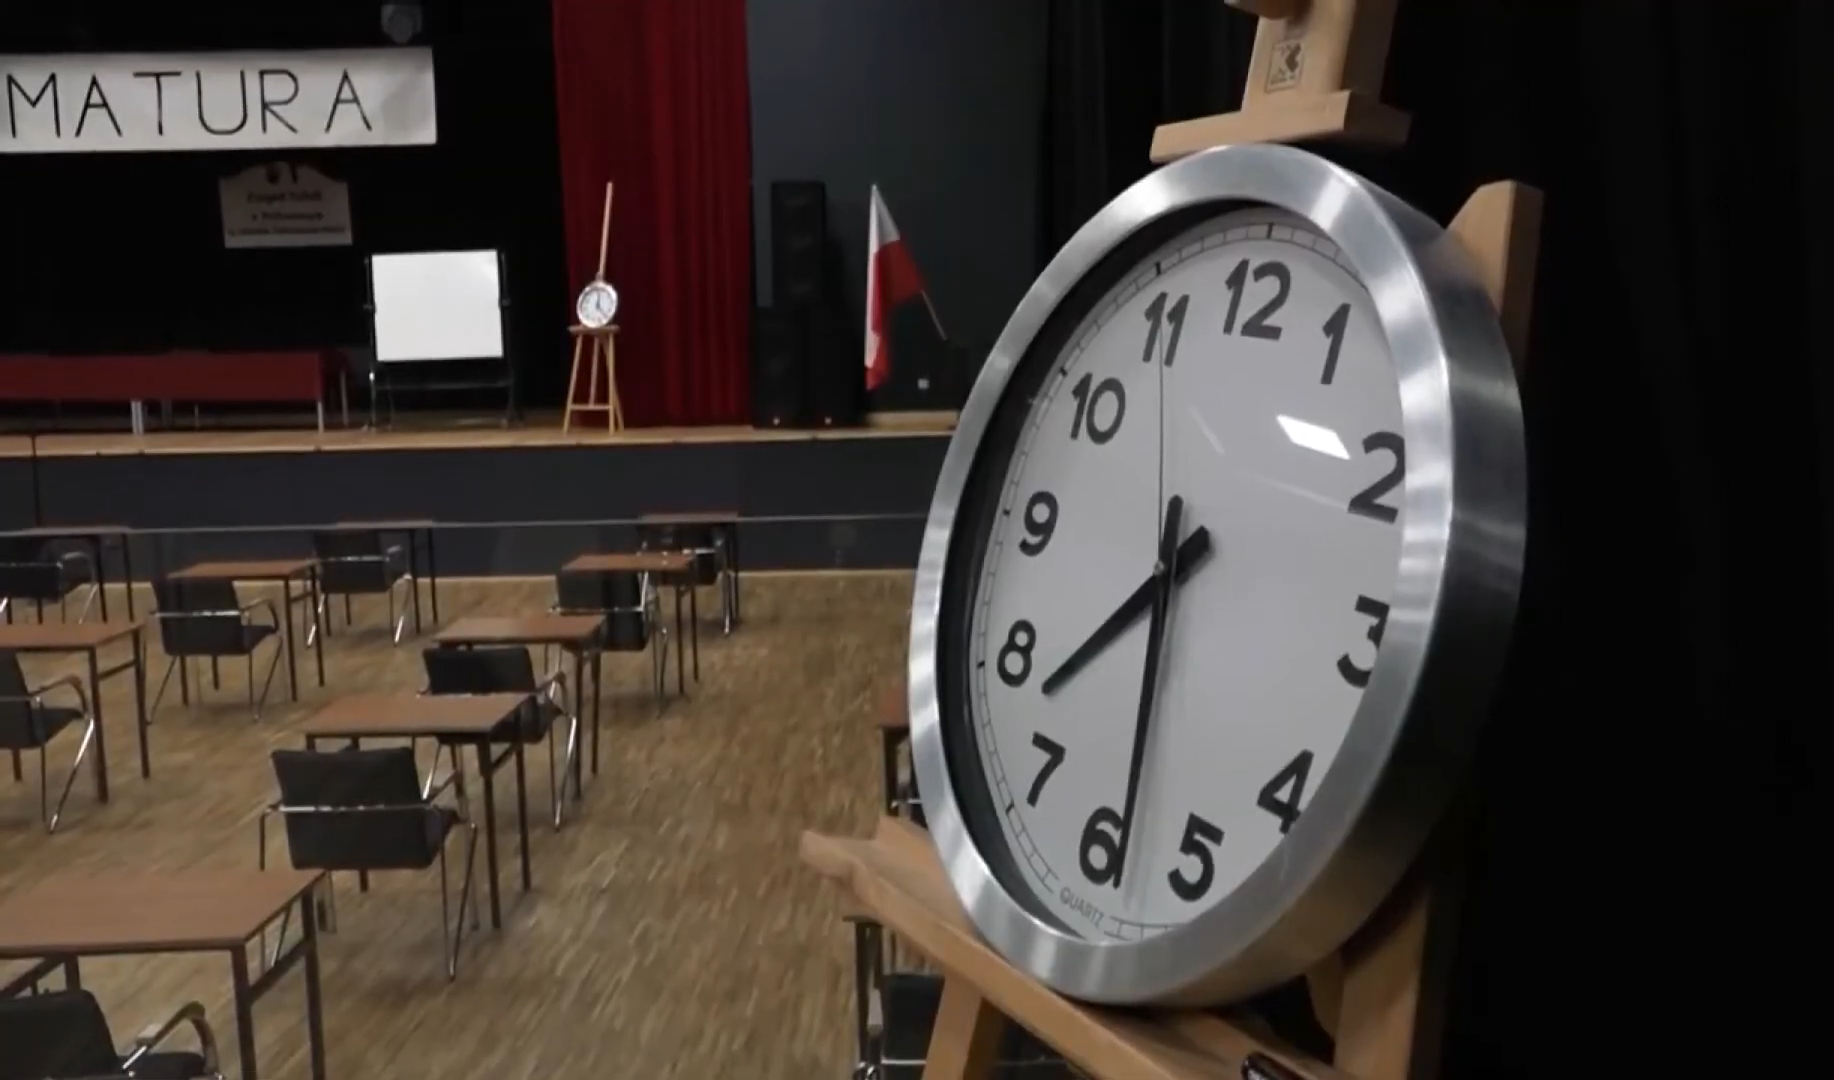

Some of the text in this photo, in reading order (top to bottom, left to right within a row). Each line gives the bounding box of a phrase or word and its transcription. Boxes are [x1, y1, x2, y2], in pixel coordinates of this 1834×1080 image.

[6, 68, 372, 138] MATURA
[1142, 292, 1189, 367] 11
[1223, 258, 1291, 340] 12
[1320, 303, 1351, 385] 1
[1070, 371, 1126, 444] 10
[1347, 431, 1406, 524] 2
[1018, 490, 1059, 556] 9
[996, 619, 1036, 687] 8
[1337, 594, 1391, 688] 3
[1026, 731, 1066, 808] 7
[1256, 749, 1315, 835] 4
[1079, 806, 1122, 886] 6
[1167, 812, 1225, 901] 5
[1060, 886, 1105, 930] QUARTZ
